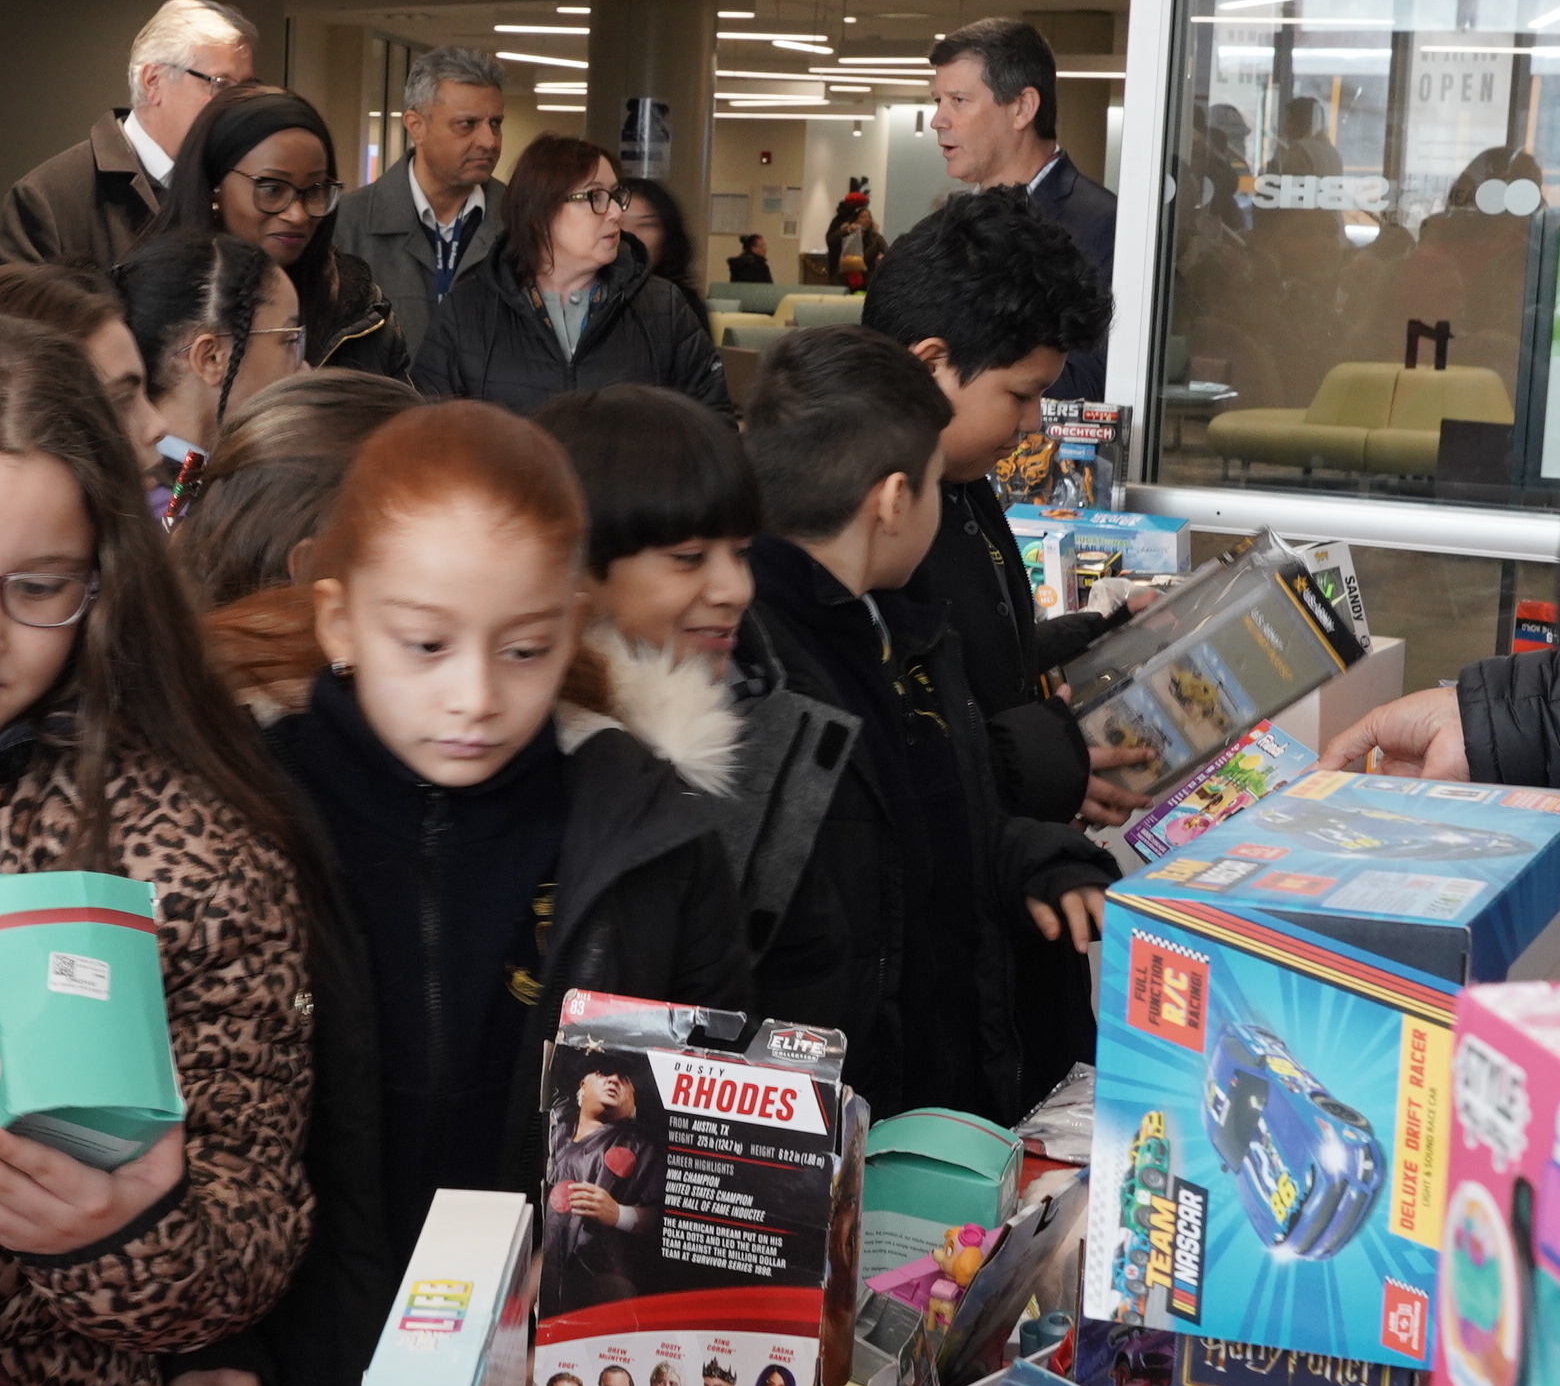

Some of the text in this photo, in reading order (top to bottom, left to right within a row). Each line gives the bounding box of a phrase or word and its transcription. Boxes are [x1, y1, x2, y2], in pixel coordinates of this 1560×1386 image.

[1418, 72, 1495, 104] OPEN
[1049, 424, 1112, 440] MECHTECH
[1344, 575, 1364, 623] SANDY
[1133, 965, 1148, 1004] FULL
[1147, 954, 1163, 1030] FUNCTION
[569, 999, 586, 1015] 83
[1161, 973, 1189, 1028] R/C
[1188, 971, 1203, 1030] RACING!
[770, 1035, 824, 1055] ELITE
[772, 1051, 819, 1061] COLLECTION
[674, 1062, 726, 1078] DUSTY
[671, 1072, 798, 1122] RHODES
[669, 1116, 730, 1137] FROM AUSTIN, TX
[1399, 1027, 1428, 1232] DELUXE DRIFT RACER
[668, 1130, 775, 1159] WEIGHT 275 kg) HEIGHT
[1421, 1087, 1437, 1208] LIGHT SOUND RACE CAR
[666, 1168, 721, 1188] NWA CHAMPION
[667, 1153, 734, 1176] CAREER HIGHLIGHTS
[665, 1180, 754, 1207] UNITED STATES CHAMPION
[664, 1193, 766, 1223] WWE HALL OF FAME INDUCTEE
[662, 1226, 778, 1257] POLKA DOTS AND LED THE DREAM
[663, 1216, 783, 1248] THE AMERICAN DREAM PUT ON HIS
[1145, 1193, 1177, 1291] TEAM
[1173, 1188, 1204, 1284] NASCAR
[661, 1247, 773, 1277] TEAM AT SURVIVOR SERIES 1990.
[662, 1237, 787, 1269] TEAM AGAINST THE MILLION DOLLAR
[413, 1281, 465, 1332] LIFE
[607, 1346, 628, 1356] DREW
[655, 1348, 683, 1361] RHODES
[660, 1341, 682, 1353] DUSTY
[706, 1343, 734, 1356] CORBIN
[714, 1337, 731, 1347] KING
[771, 1345, 794, 1356] SASHA
[558, 1362, 575, 1370] EDGE
[598, 1352, 632, 1365] McINTYRE
[768, 1352, 793, 1364] BANKS
